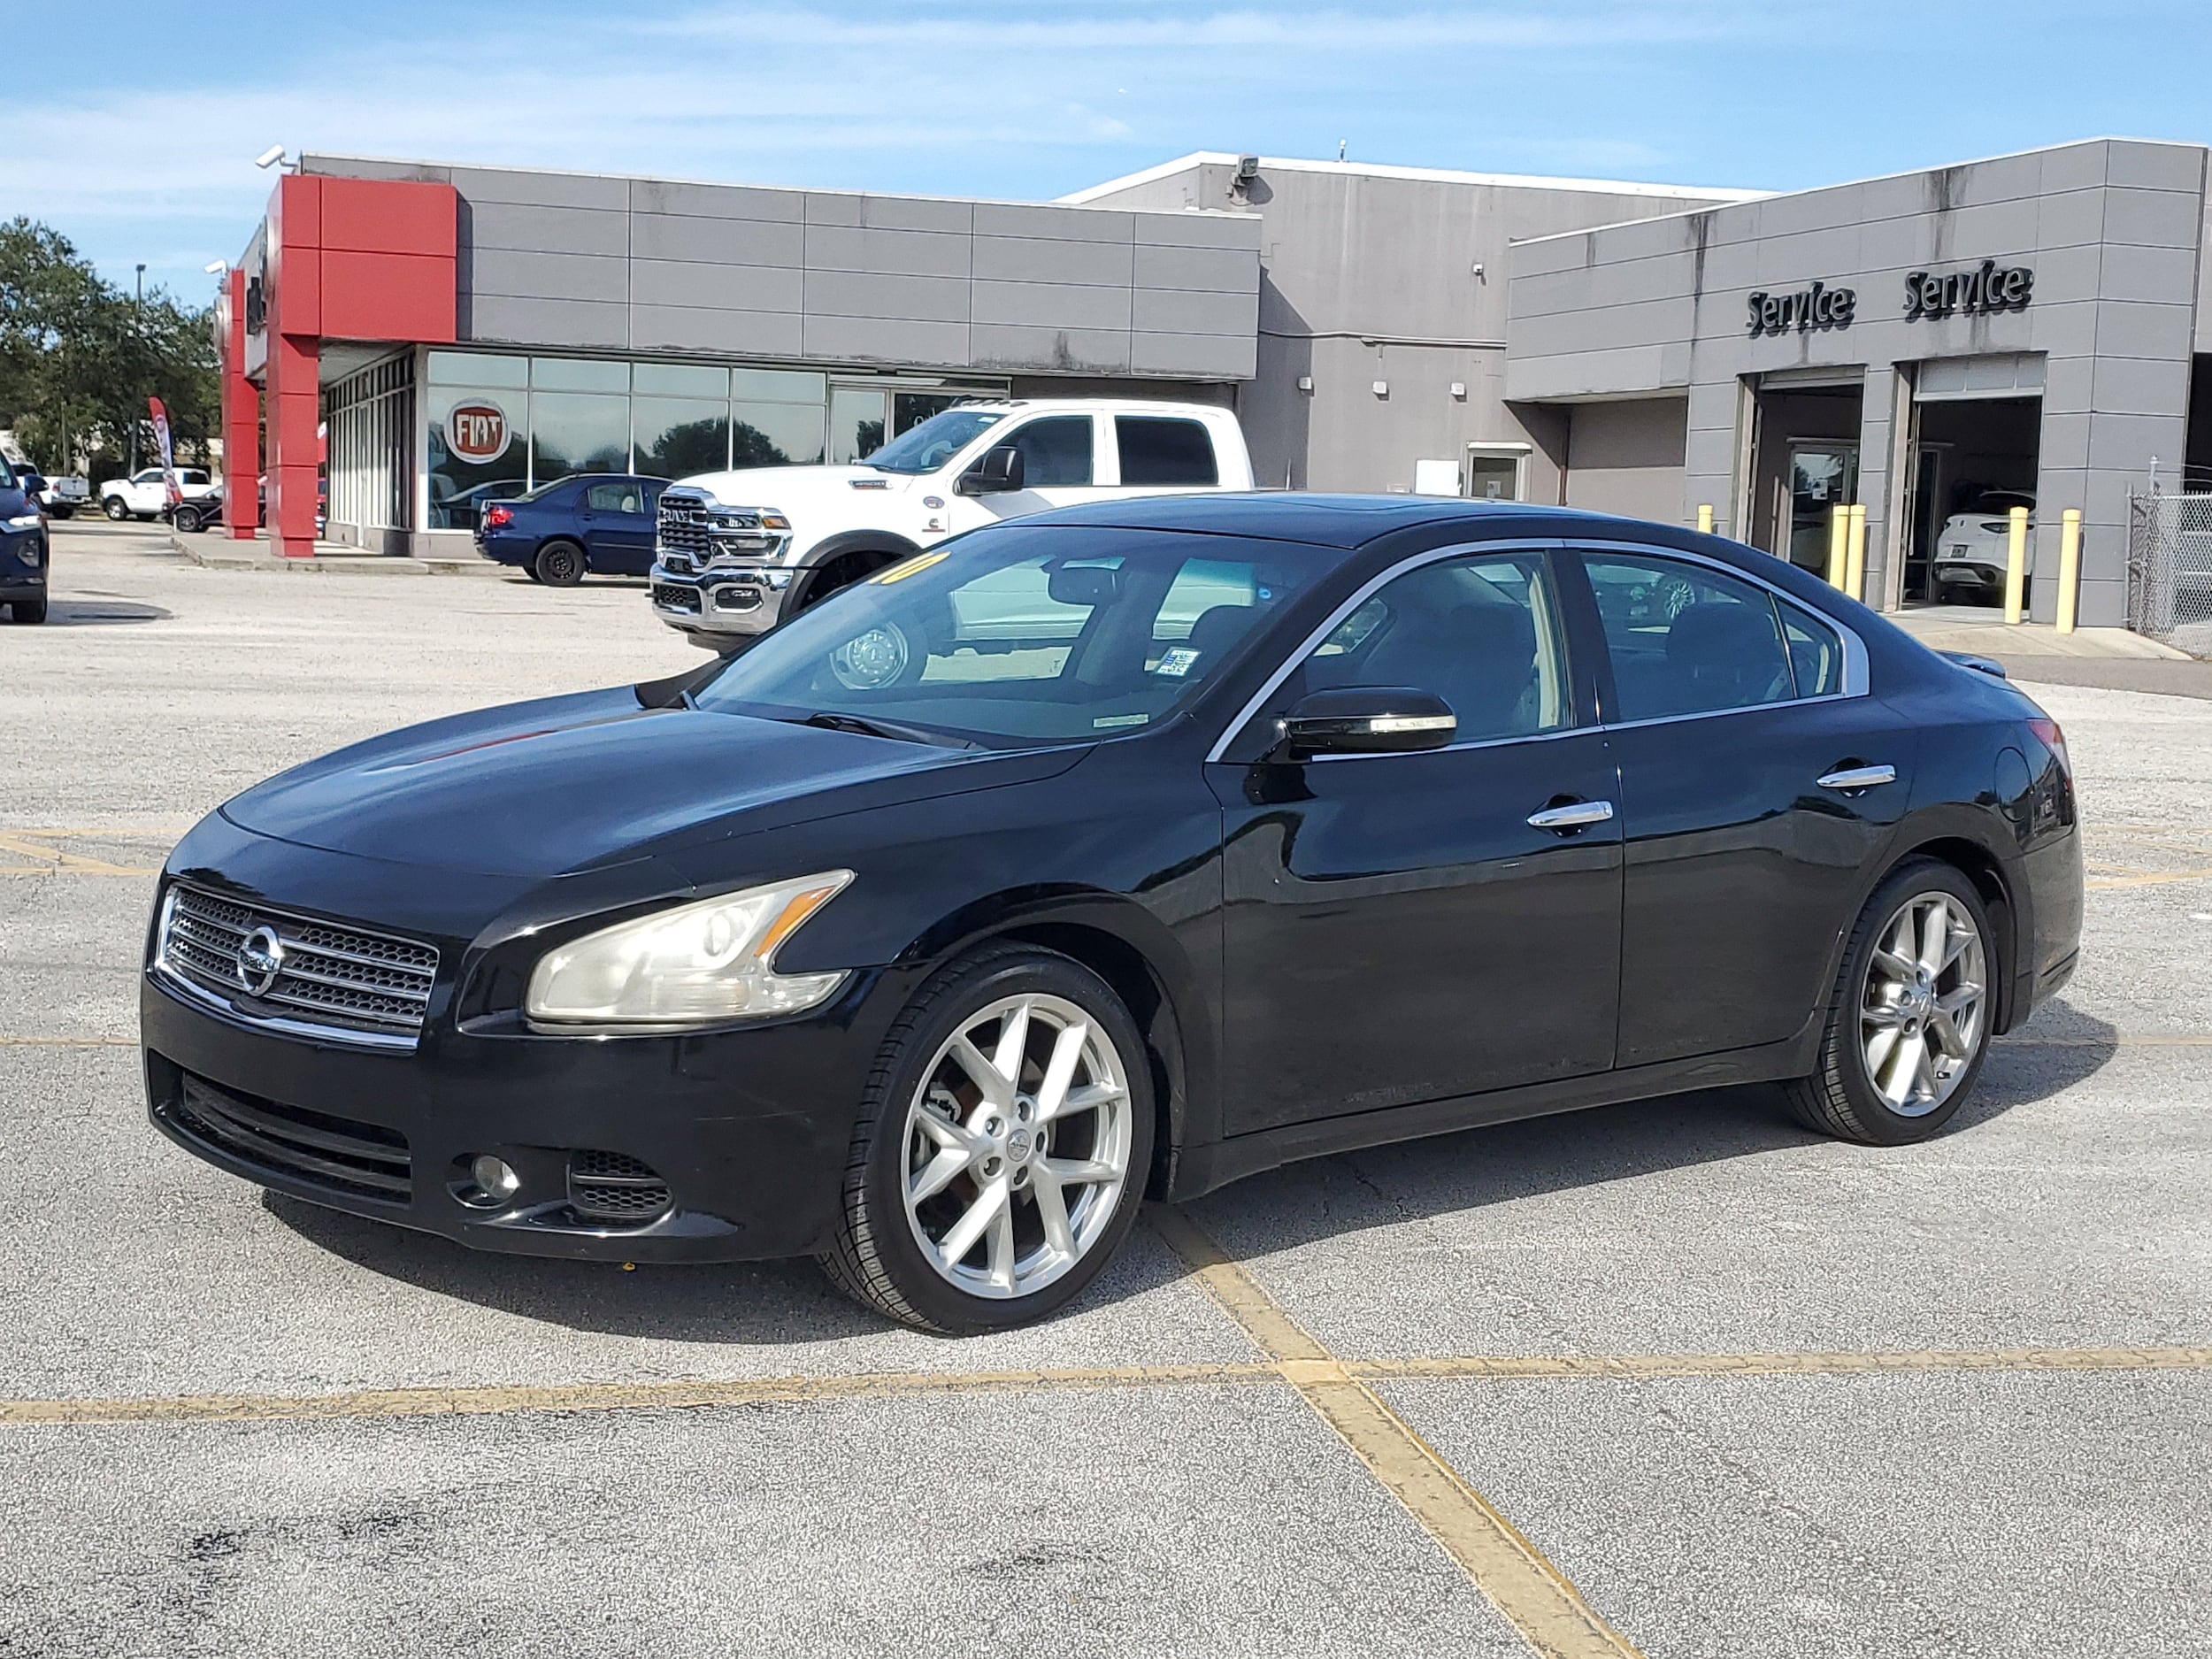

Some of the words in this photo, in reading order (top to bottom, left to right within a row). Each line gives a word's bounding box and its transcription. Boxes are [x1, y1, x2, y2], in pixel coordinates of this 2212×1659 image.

[1747, 281, 1855, 331] Service
[1903, 259, 2033, 313] Service
[457, 413, 501, 448] FIAT
